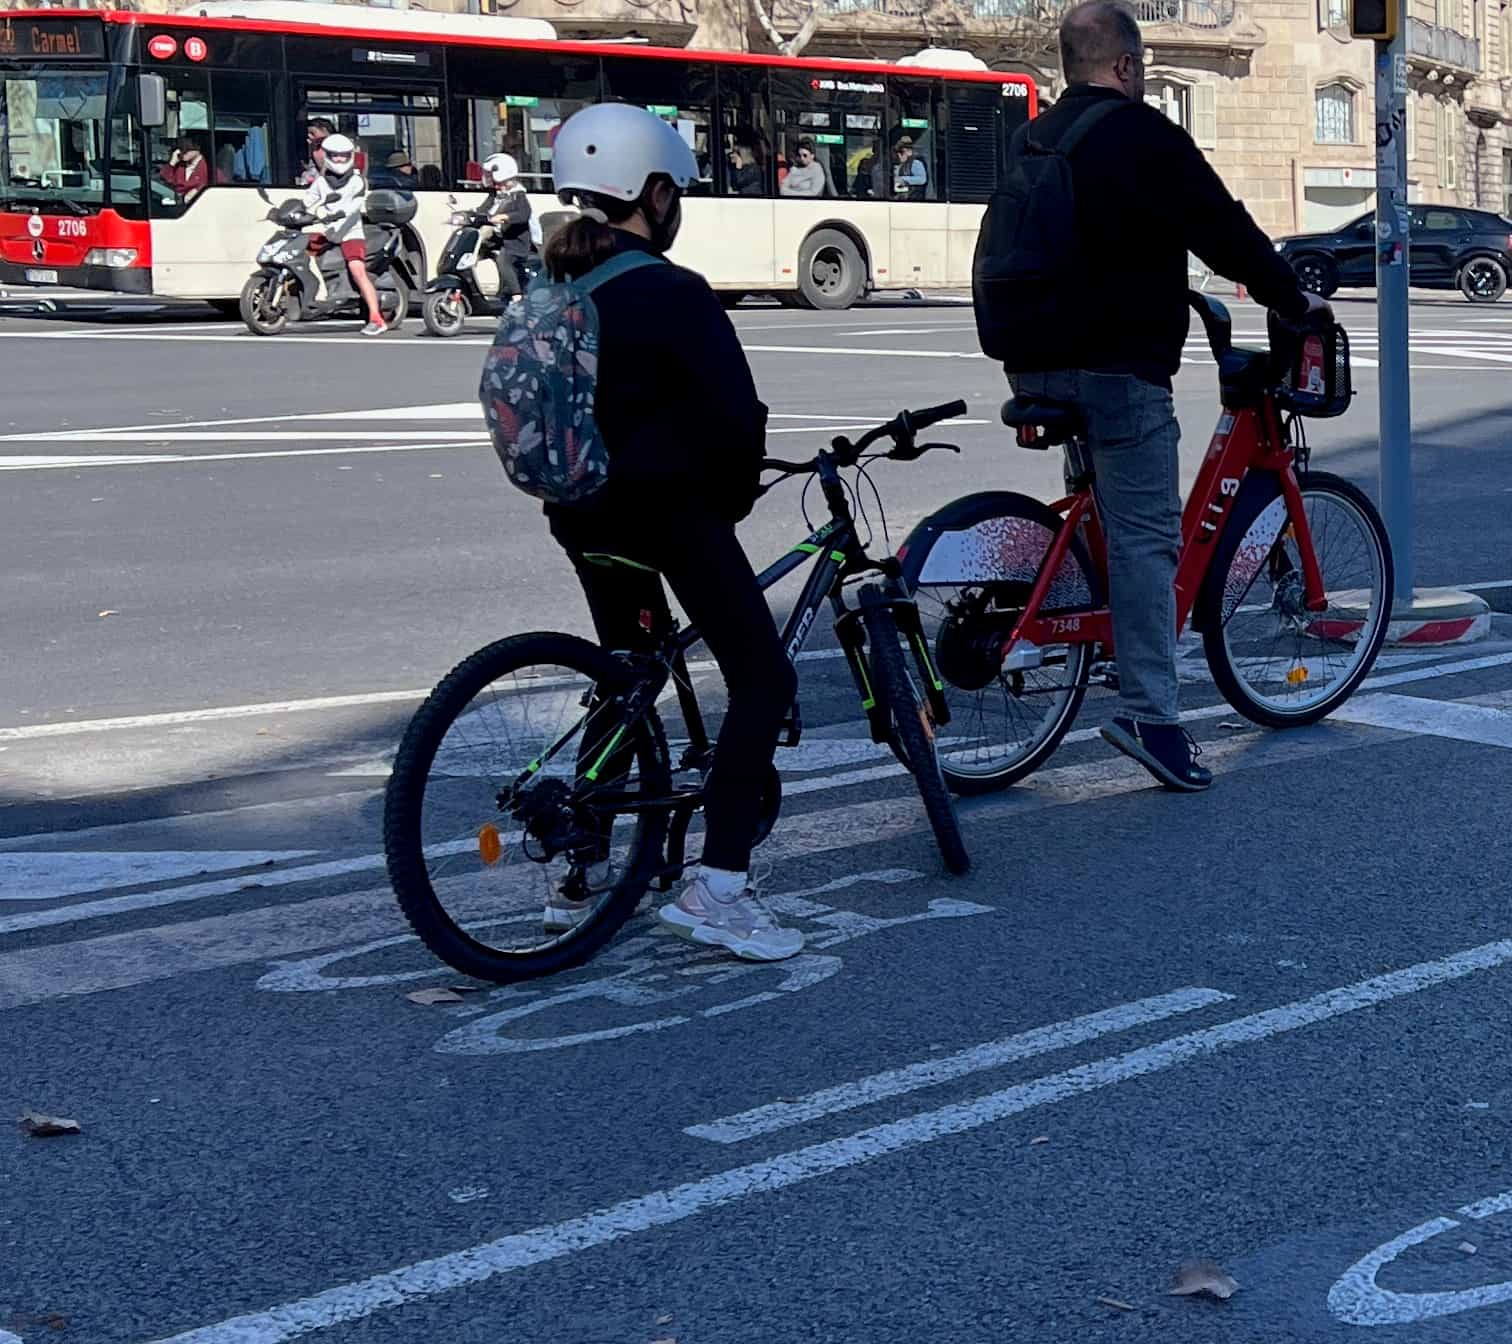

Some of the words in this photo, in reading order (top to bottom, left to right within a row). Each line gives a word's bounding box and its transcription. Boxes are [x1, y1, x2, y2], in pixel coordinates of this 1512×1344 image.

[31, 27, 81, 53] Carmel
[1002, 83, 1028, 97] 2706
[58, 219, 87, 236] 2706
[1051, 617, 1081, 634] 7348
